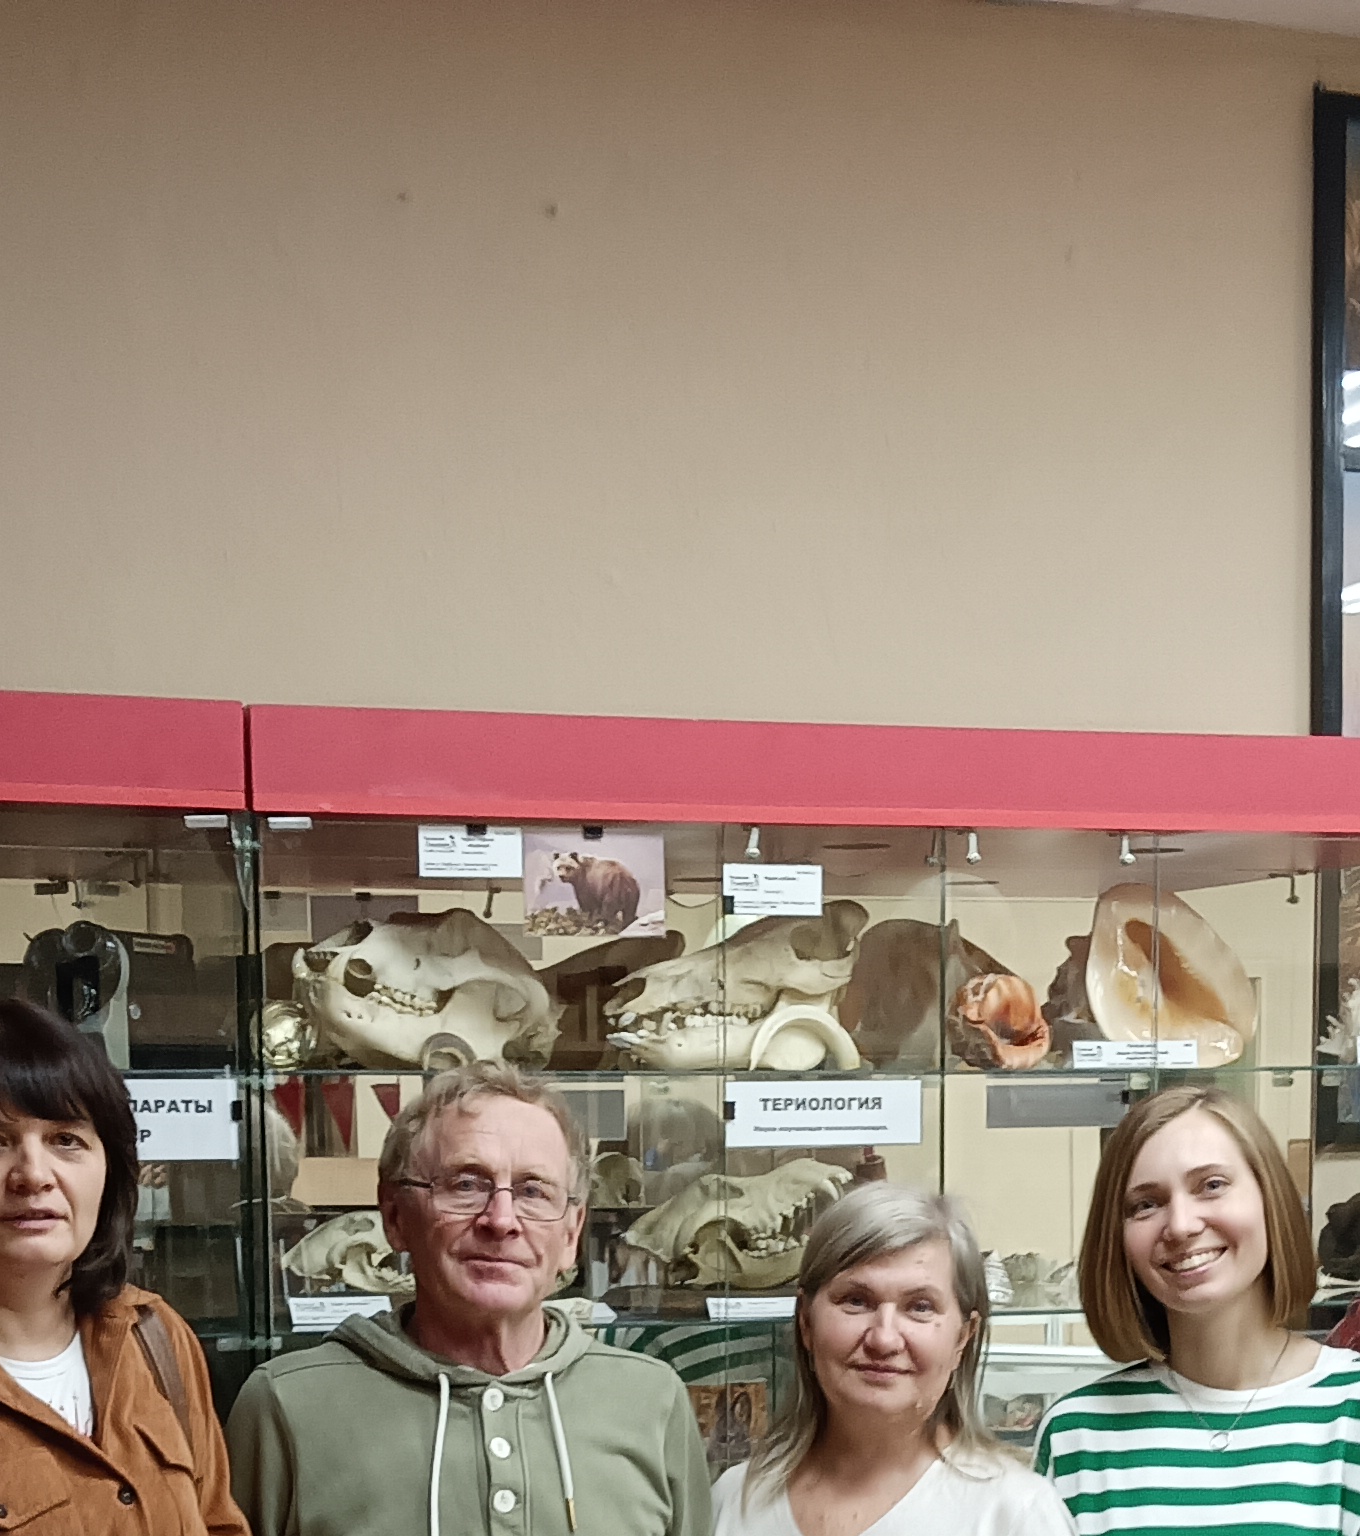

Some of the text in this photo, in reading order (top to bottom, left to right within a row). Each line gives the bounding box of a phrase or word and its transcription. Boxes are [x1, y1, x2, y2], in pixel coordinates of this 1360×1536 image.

[129, 1098, 213, 1114] ПАРАТЫ
[759, 1096, 883, 1112] ТЕРИОЛОГИЯ
[139, 1129, 152, 1143] Р
